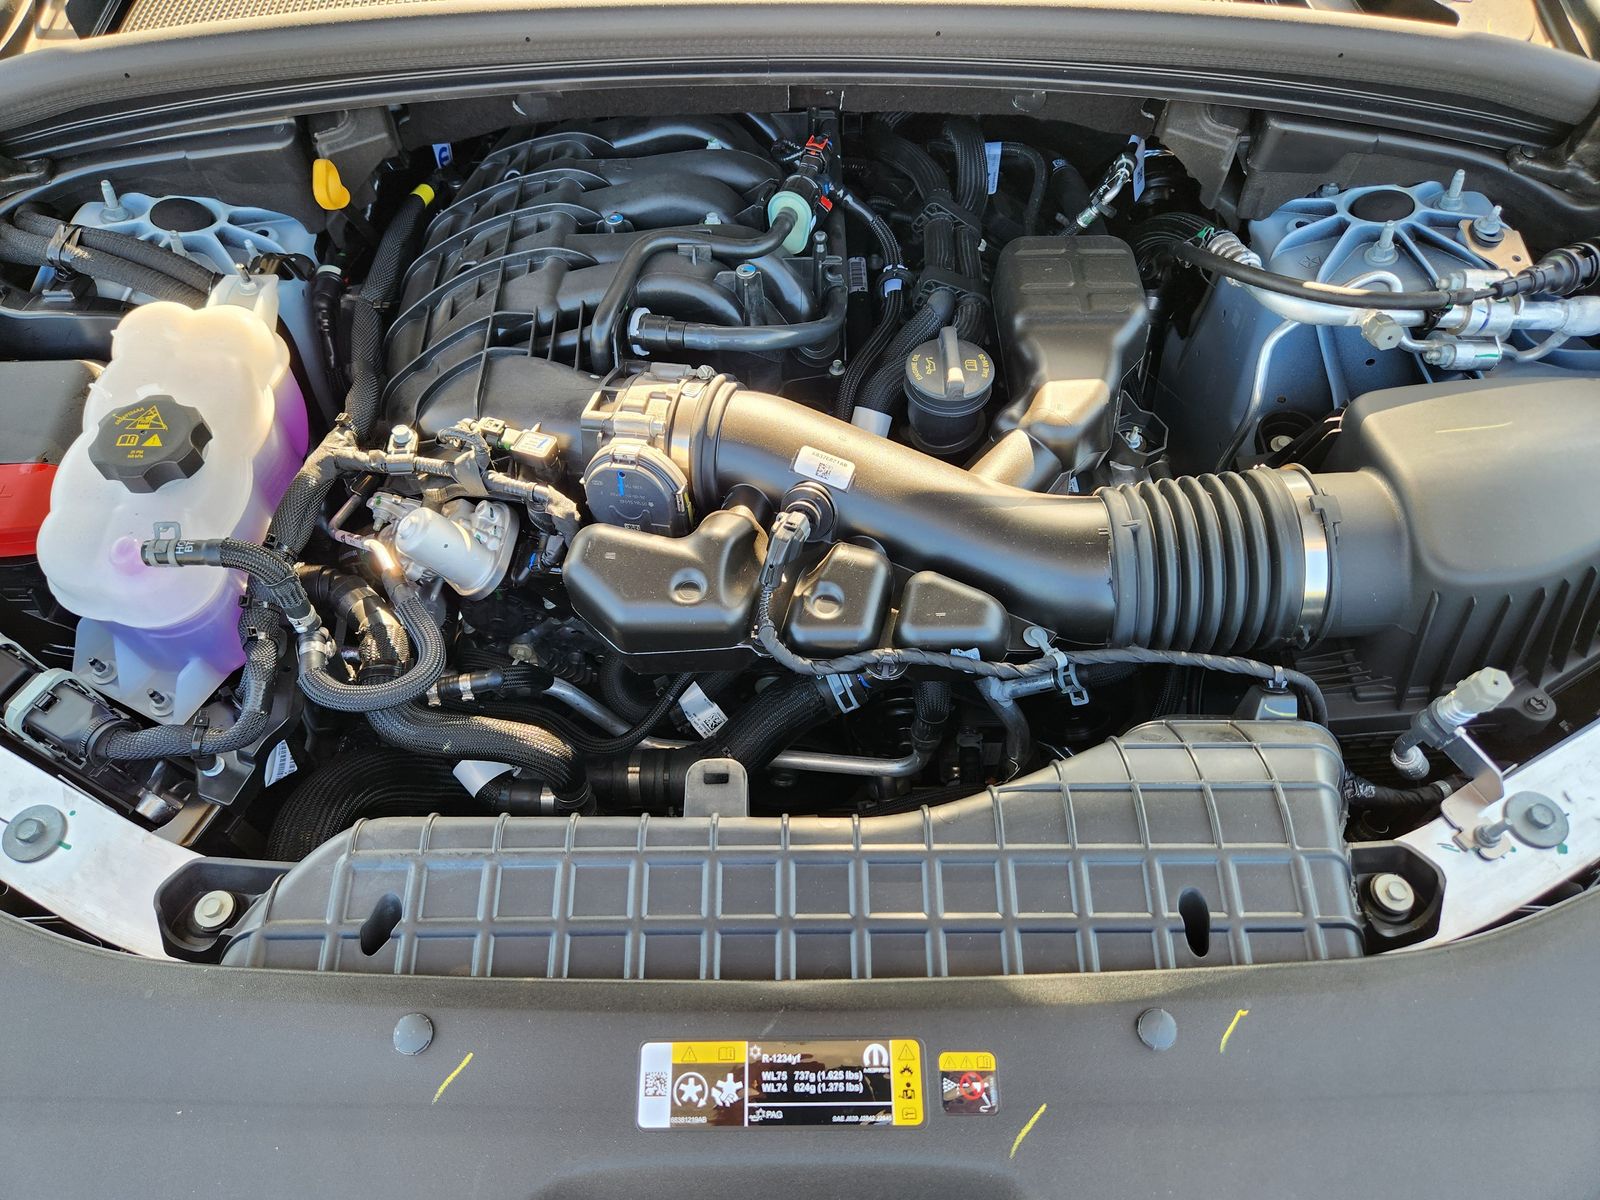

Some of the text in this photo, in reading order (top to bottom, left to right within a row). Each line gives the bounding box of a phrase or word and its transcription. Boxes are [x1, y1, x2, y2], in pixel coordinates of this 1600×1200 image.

[761, 1053, 802, 1065] R-1234yf
[761, 1070, 864, 1082] WL75 737g (1.625 lbs)
[761, 1082, 864, 1094] WL74 624g (1.375 lbs)
[766, 1110, 784, 1119] PAG
